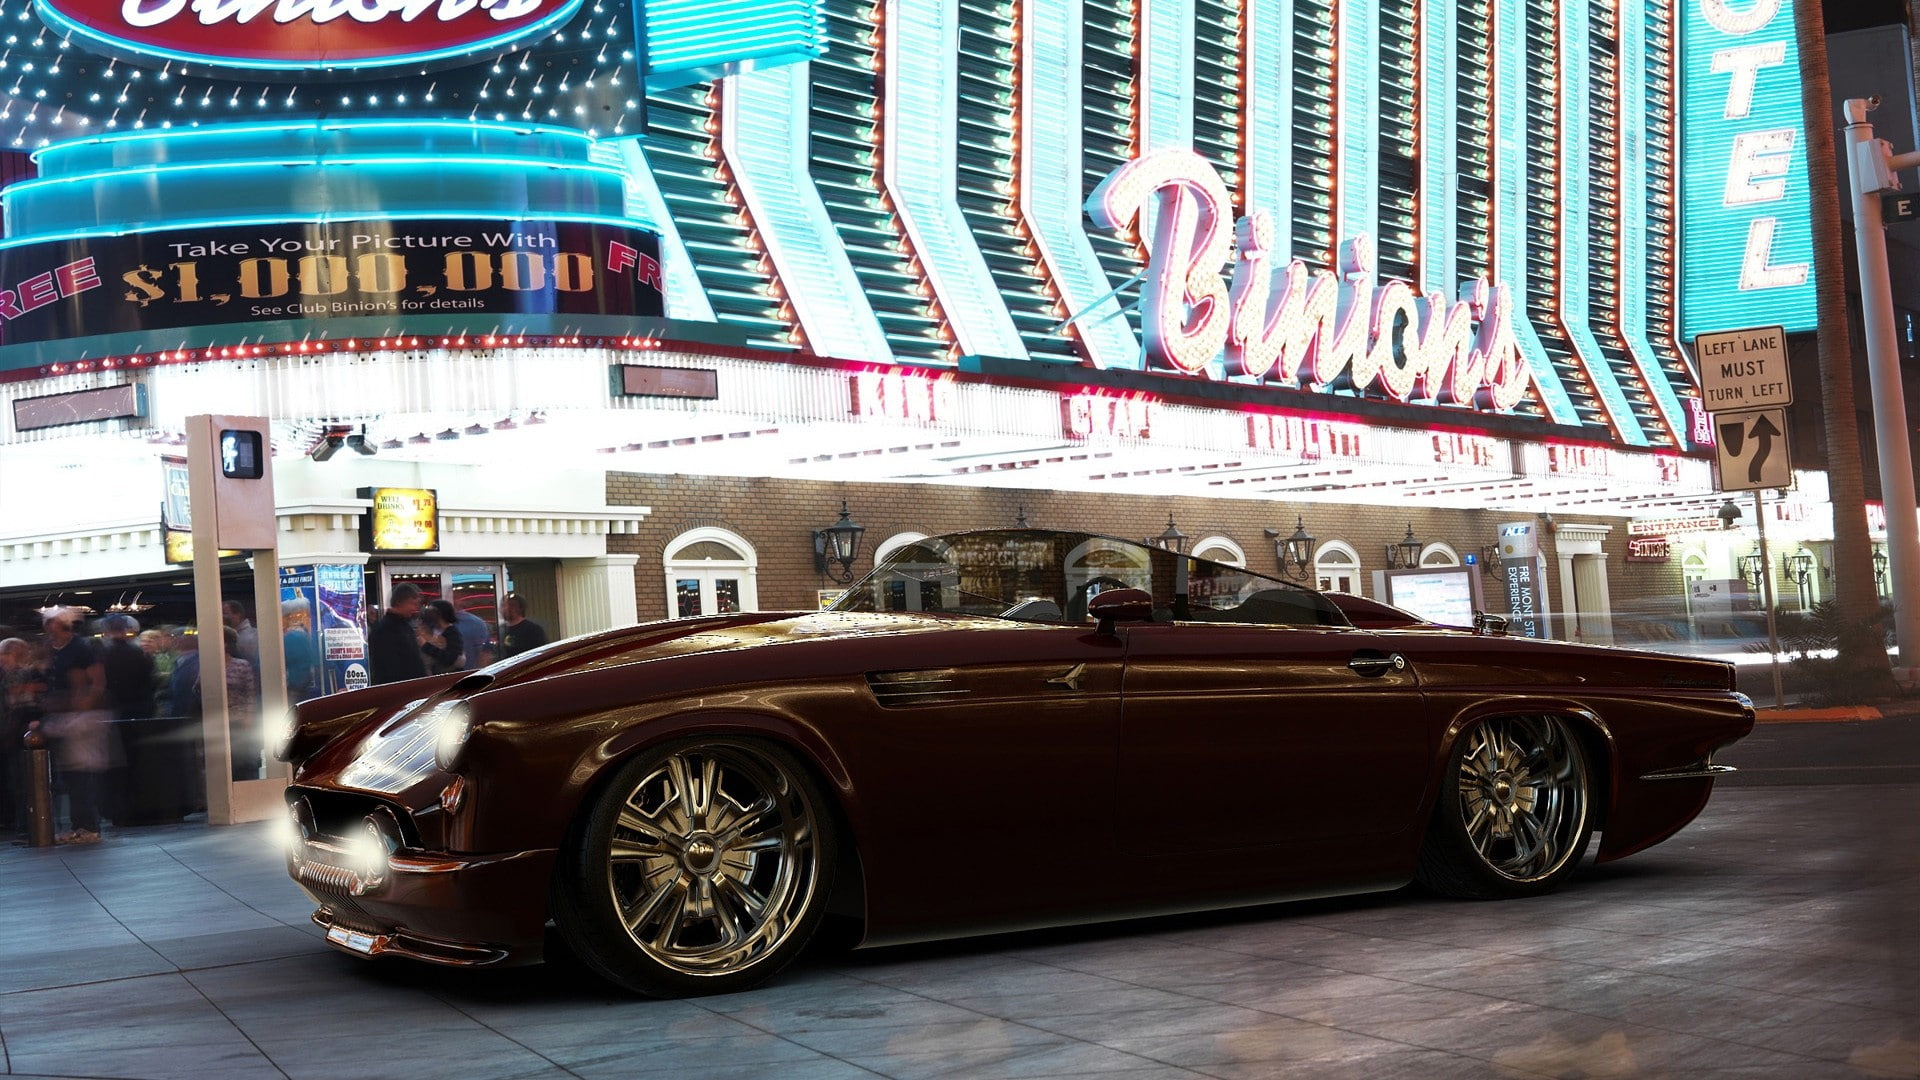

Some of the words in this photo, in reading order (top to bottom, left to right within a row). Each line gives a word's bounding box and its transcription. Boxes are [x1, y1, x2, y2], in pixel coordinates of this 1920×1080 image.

[1897, 199, 1913, 216] E
[168, 240, 250, 258] Take
[259, 236, 341, 254] Your
[351, 233, 474, 250] Picture
[481, 232, 557, 249] With
[121, 249, 595, 308] $1,000,000
[1086, 149, 1530, 412] Binion's
[250, 305, 282, 317] See
[286, 302, 327, 315] Club
[331, 300, 398, 314] Binion's
[401, 299, 426, 311] for
[429, 297, 486, 310] details
[1704, 341, 1736, 356] LEFT
[1743, 336, 1777, 352] LANE
[1720, 359, 1765, 379] MUST
[1708, 386, 1743, 402] TURN
[1752, 382, 1784, 398] LEFT
[1504, 525, 1527, 537] ACE
[1632, 519, 1720, 533] ENTRANCE
[1508, 566, 1522, 624] EXPERIENCE
[346, 670, 366, 678] 80oz.
